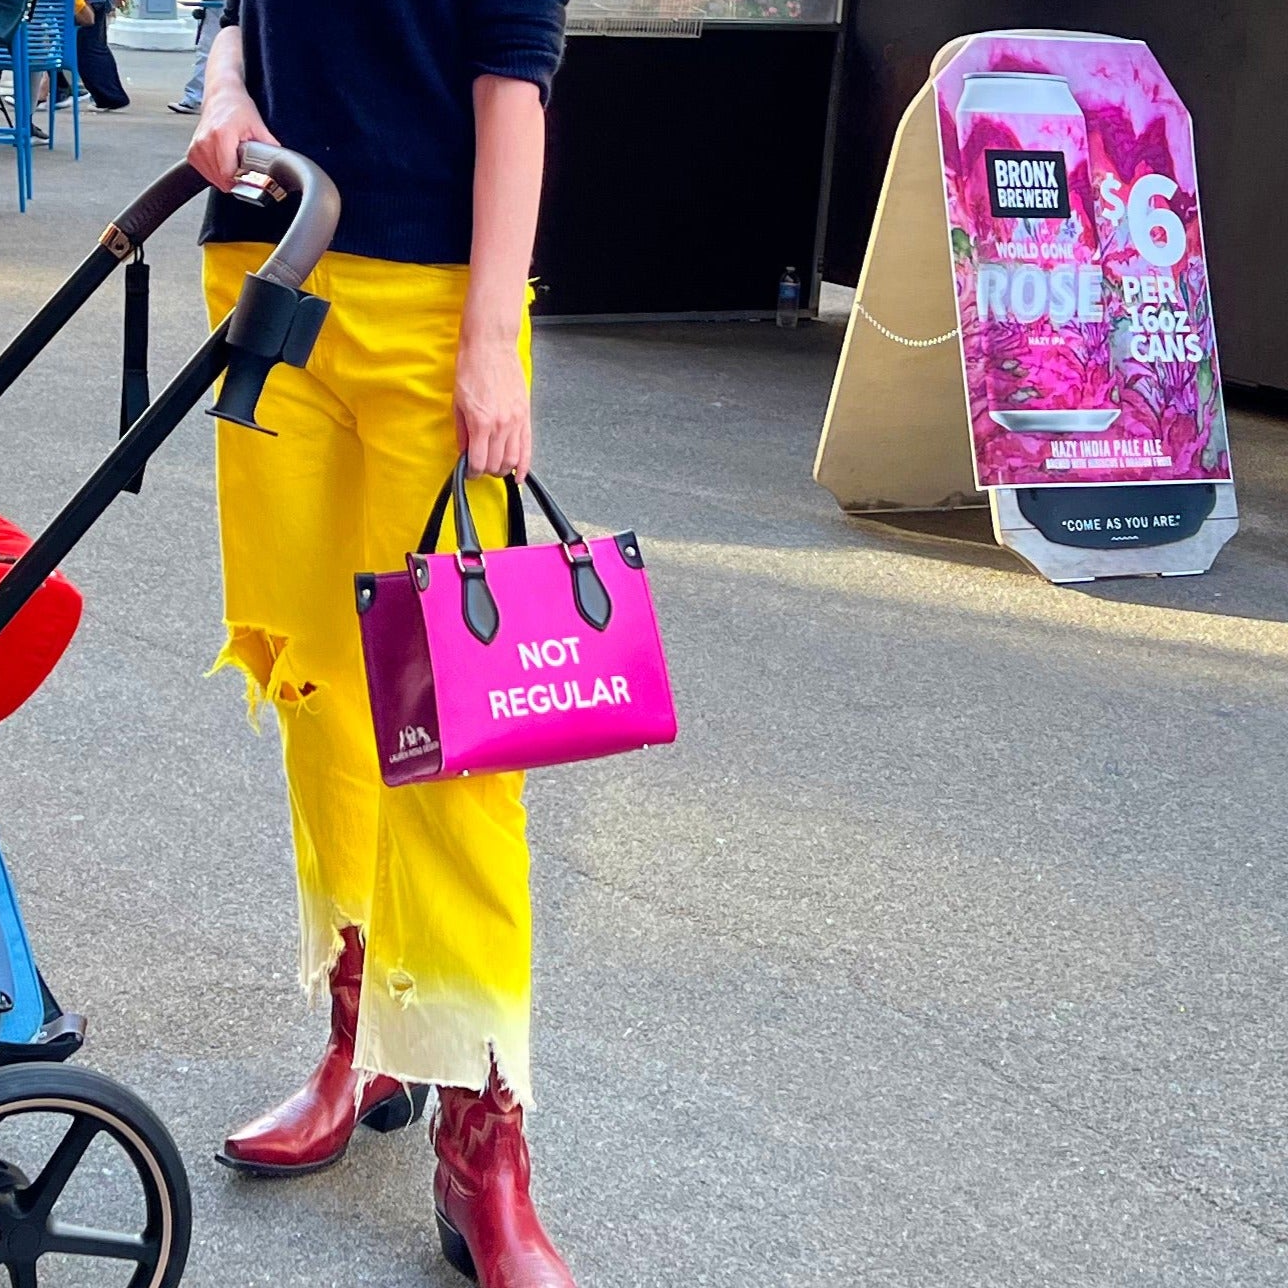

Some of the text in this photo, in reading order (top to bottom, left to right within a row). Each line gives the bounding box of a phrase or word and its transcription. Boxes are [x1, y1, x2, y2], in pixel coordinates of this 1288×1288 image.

[994, 159, 1059, 188] BRONX
[997, 188, 1059, 209] BREWERY
[1099, 172, 1187, 268] $6
[995, 241, 1039, 259] WORLD
[1121, 275, 1179, 304] PER
[1051, 336, 1066, 346] IPA
[1129, 333, 1204, 363] CANS
[1050, 438, 1164, 458] HAZY INDIA PALE ALE
[1106, 517, 1122, 530] AS
[1125, 516, 1149, 529] YOU
[517, 637, 580, 671] NOT
[488, 675, 632, 720] REGULAR
